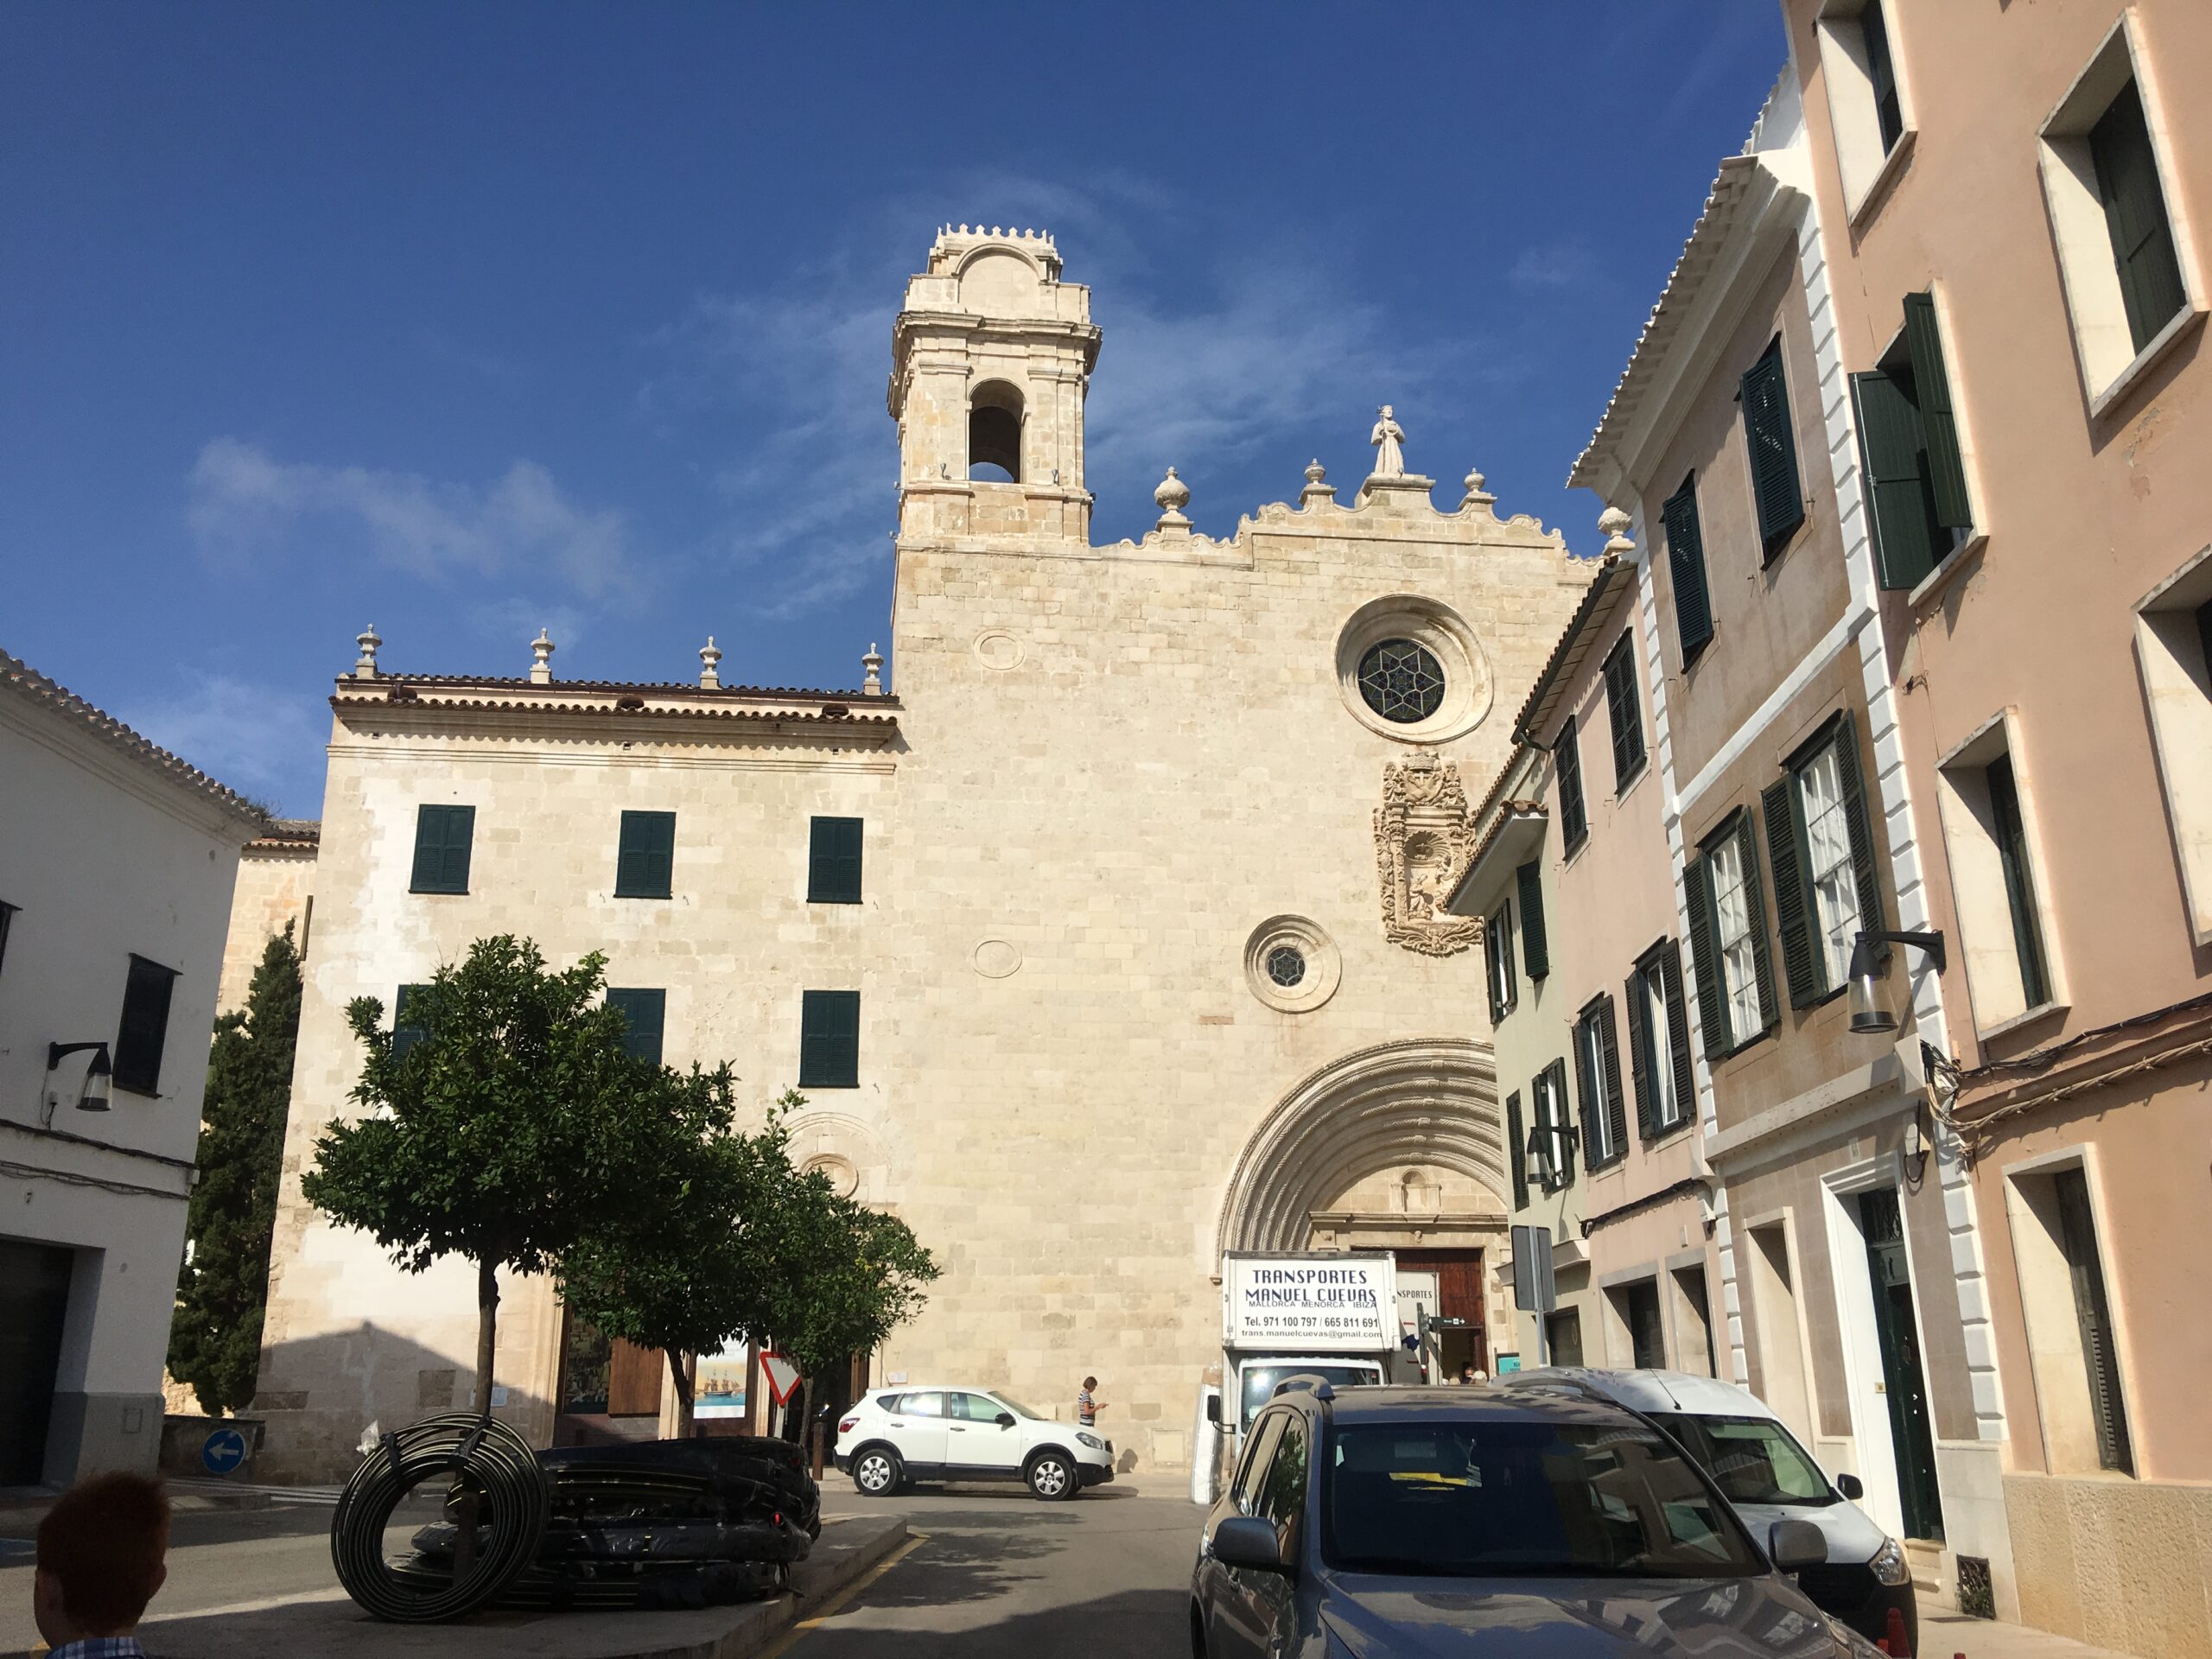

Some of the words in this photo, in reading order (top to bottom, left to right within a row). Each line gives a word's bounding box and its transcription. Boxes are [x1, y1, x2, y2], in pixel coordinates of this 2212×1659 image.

[1252, 1269, 1367, 1284] TRANSPORTES
[1245, 1288, 1311, 1302] MANUEL
[1317, 1288, 1376, 1303] CUEVAS
[1397, 1290, 1433, 1299] NSPORTES
[1244, 1316, 1261, 1326] Tel.
[1263, 1316, 1279, 1326] 971
[1282, 1317, 1299, 1326] 100
[1300, 1317, 1317, 1327] 797
[1325, 1317, 1341, 1327] 665
[1344, 1318, 1359, 1328] 811
[1362, 1318, 1378, 1328] 691
[1242, 1330, 1382, 1339] trans.manuelcuevas@gmail.com
